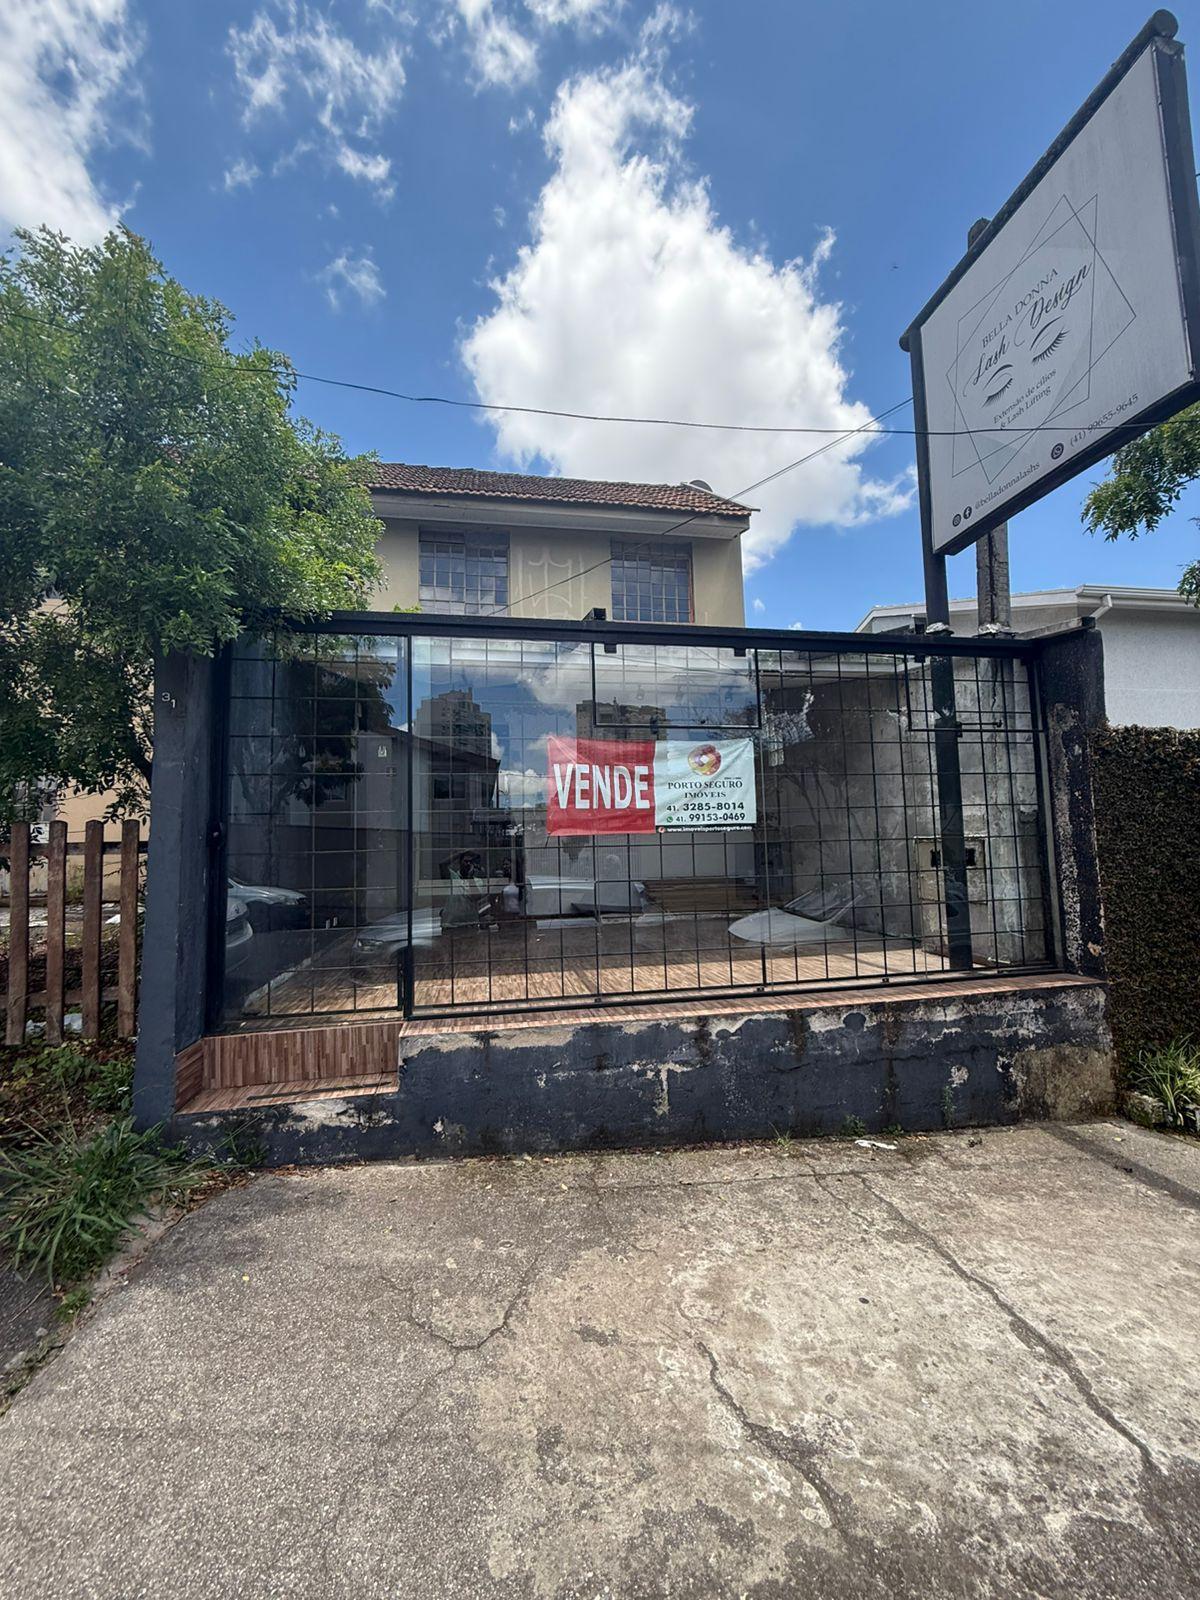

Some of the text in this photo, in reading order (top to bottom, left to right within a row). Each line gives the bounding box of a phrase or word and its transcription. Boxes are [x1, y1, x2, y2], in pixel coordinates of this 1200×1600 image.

[982, 268, 1058, 348] BELLA DONNA
[963, 262, 1092, 397] Lash Design
[1007, 405, 1025, 424] Lash
[1025, 385, 1052, 410] Lifting
[1025, 386, 1035, 399] de
[1070, 393, 1138, 447] (41) 99655-9645
[975, 462, 1041, 510] @belladonnalashs
[553, 763, 651, 809] VENDE
[667, 780, 743, 790] PORTO SEGURO
[683, 802, 745, 811] 3285-8014
[689, 812, 746, 822] 99153-0469
